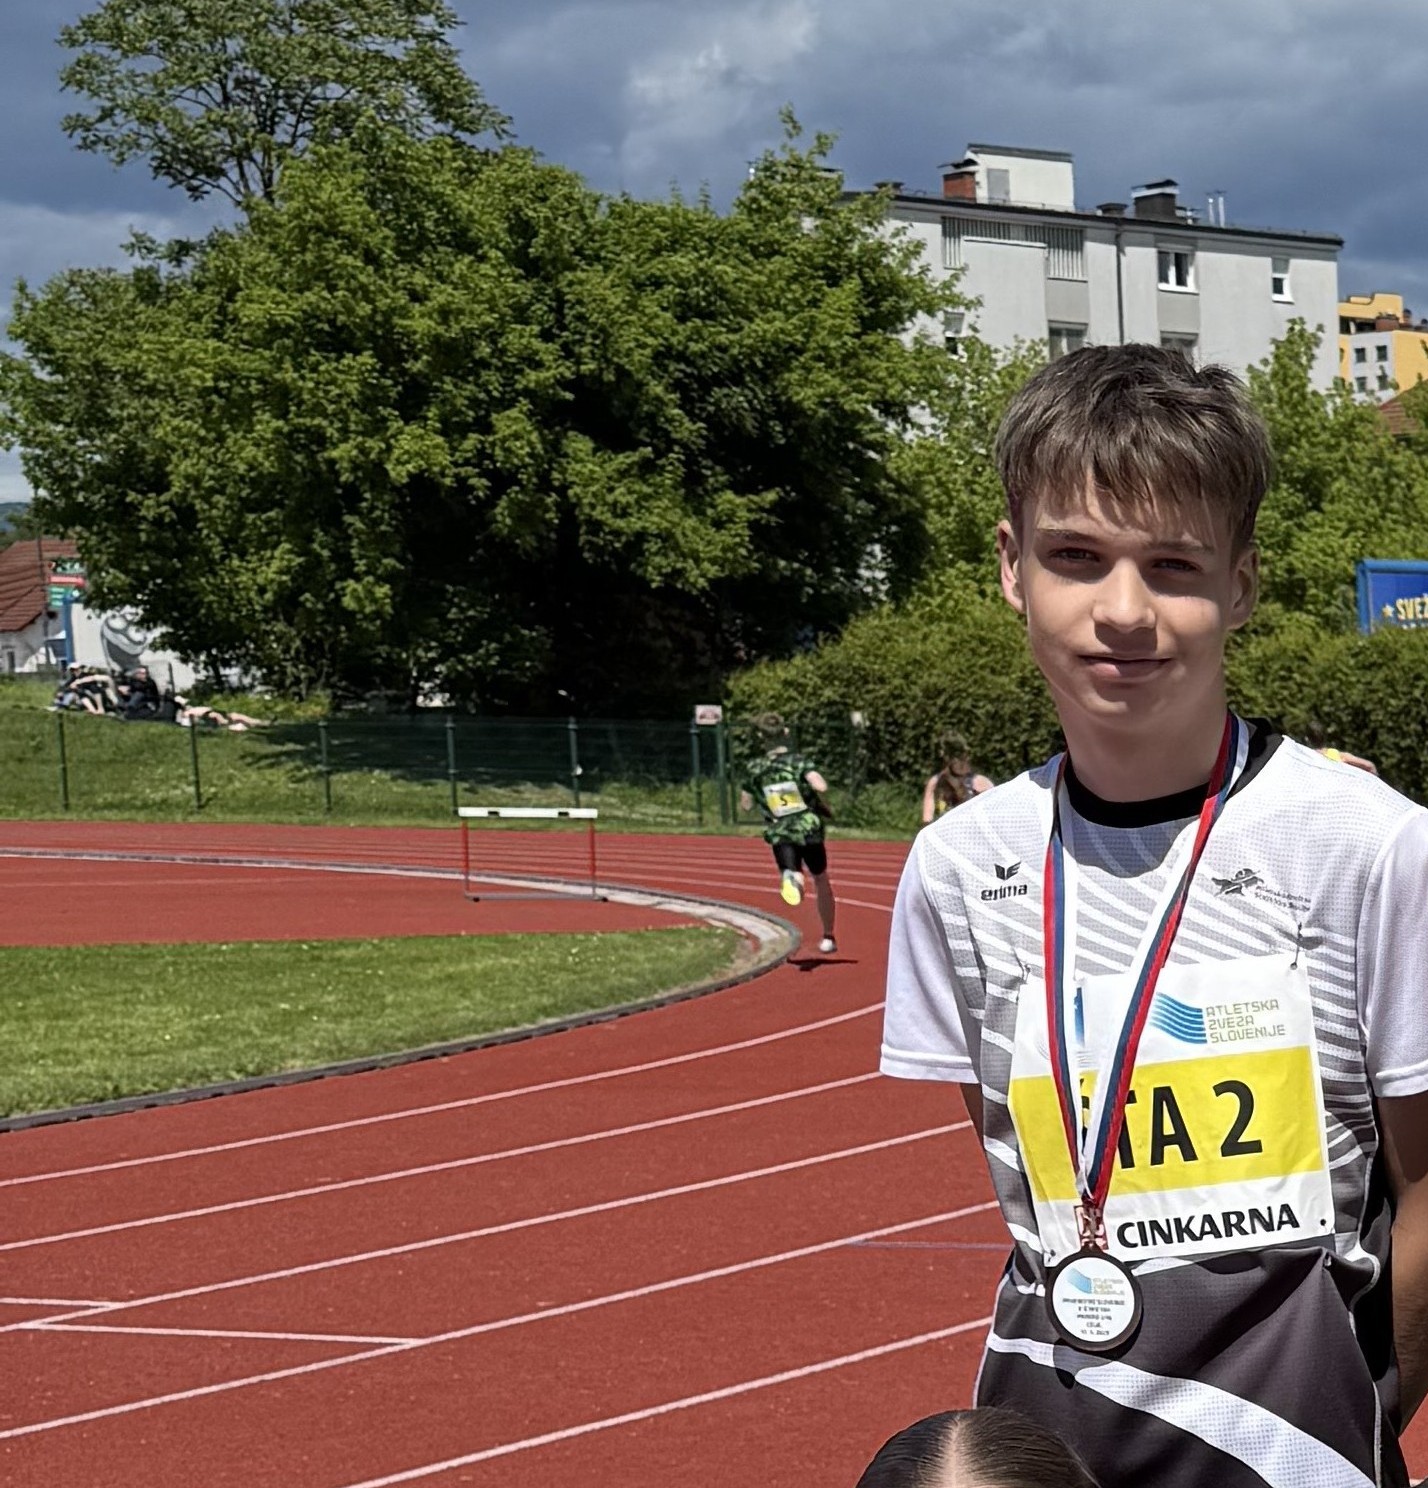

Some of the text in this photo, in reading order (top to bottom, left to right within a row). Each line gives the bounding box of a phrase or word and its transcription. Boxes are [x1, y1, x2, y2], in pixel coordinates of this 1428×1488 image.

[981, 881, 1027, 901] erima
[1206, 998, 1280, 1019] ATLETSKA
[1207, 1016, 1254, 1033] ZVEZA
[1210, 1024, 1286, 1044] SLOVENIJE
[1213, 1080, 1263, 1157] 2
[1117, 1203, 1300, 1248] CINKARNA
